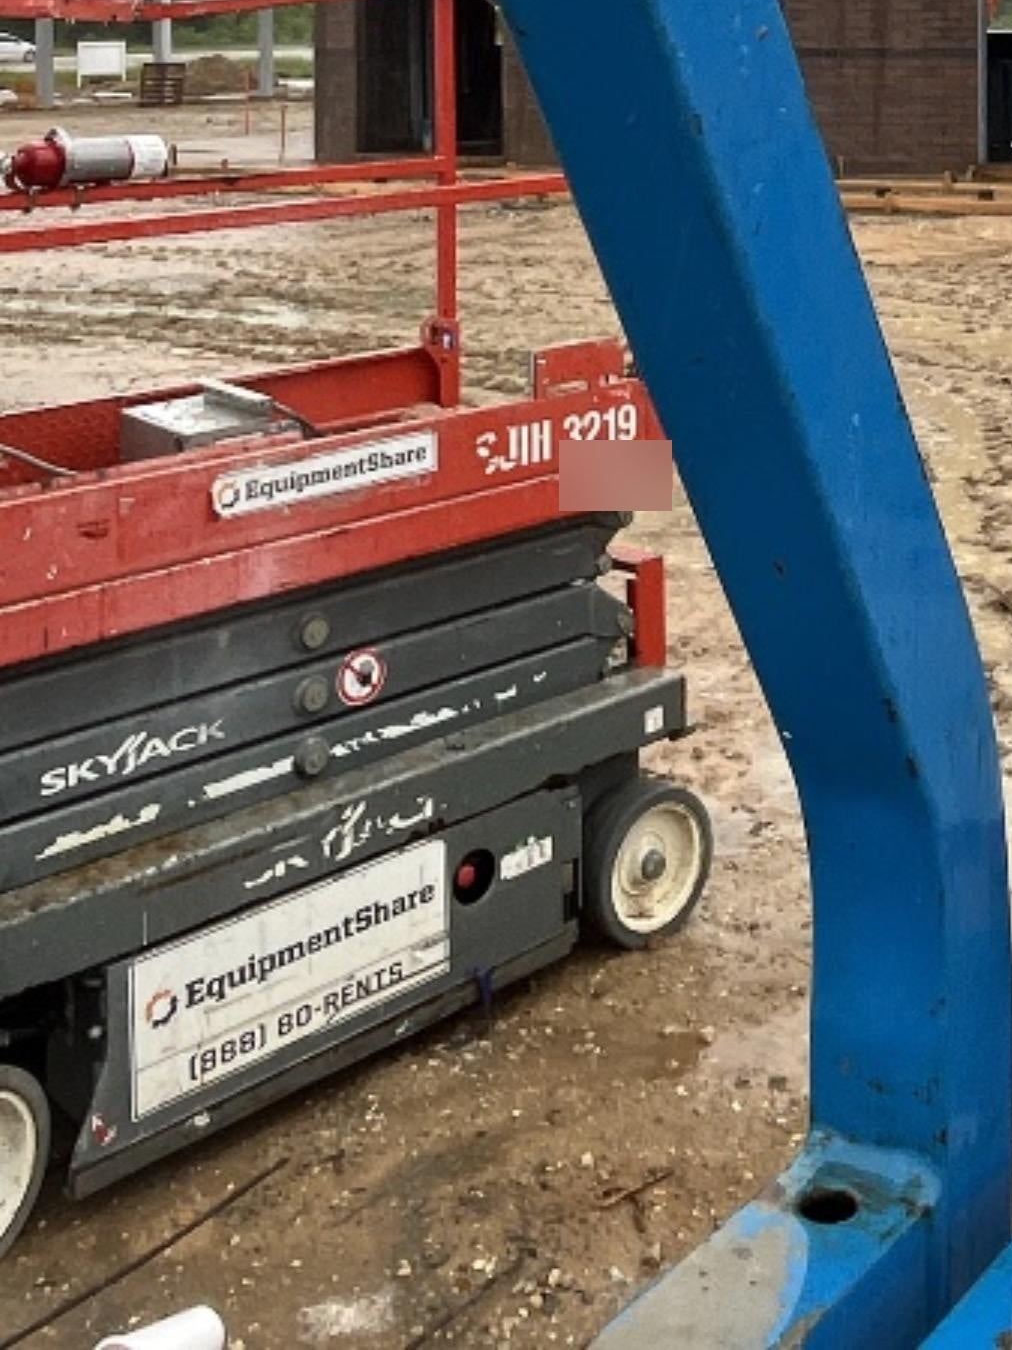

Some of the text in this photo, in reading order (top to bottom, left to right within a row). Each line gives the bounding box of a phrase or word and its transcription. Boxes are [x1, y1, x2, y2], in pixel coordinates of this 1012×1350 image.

[244, 446, 428, 501] EquipmentShare
[40, 719, 226, 797] SKYJACK
[185, 883, 436, 1010] EquipmentShare
[189, 1023, 268, 1081] (888)
